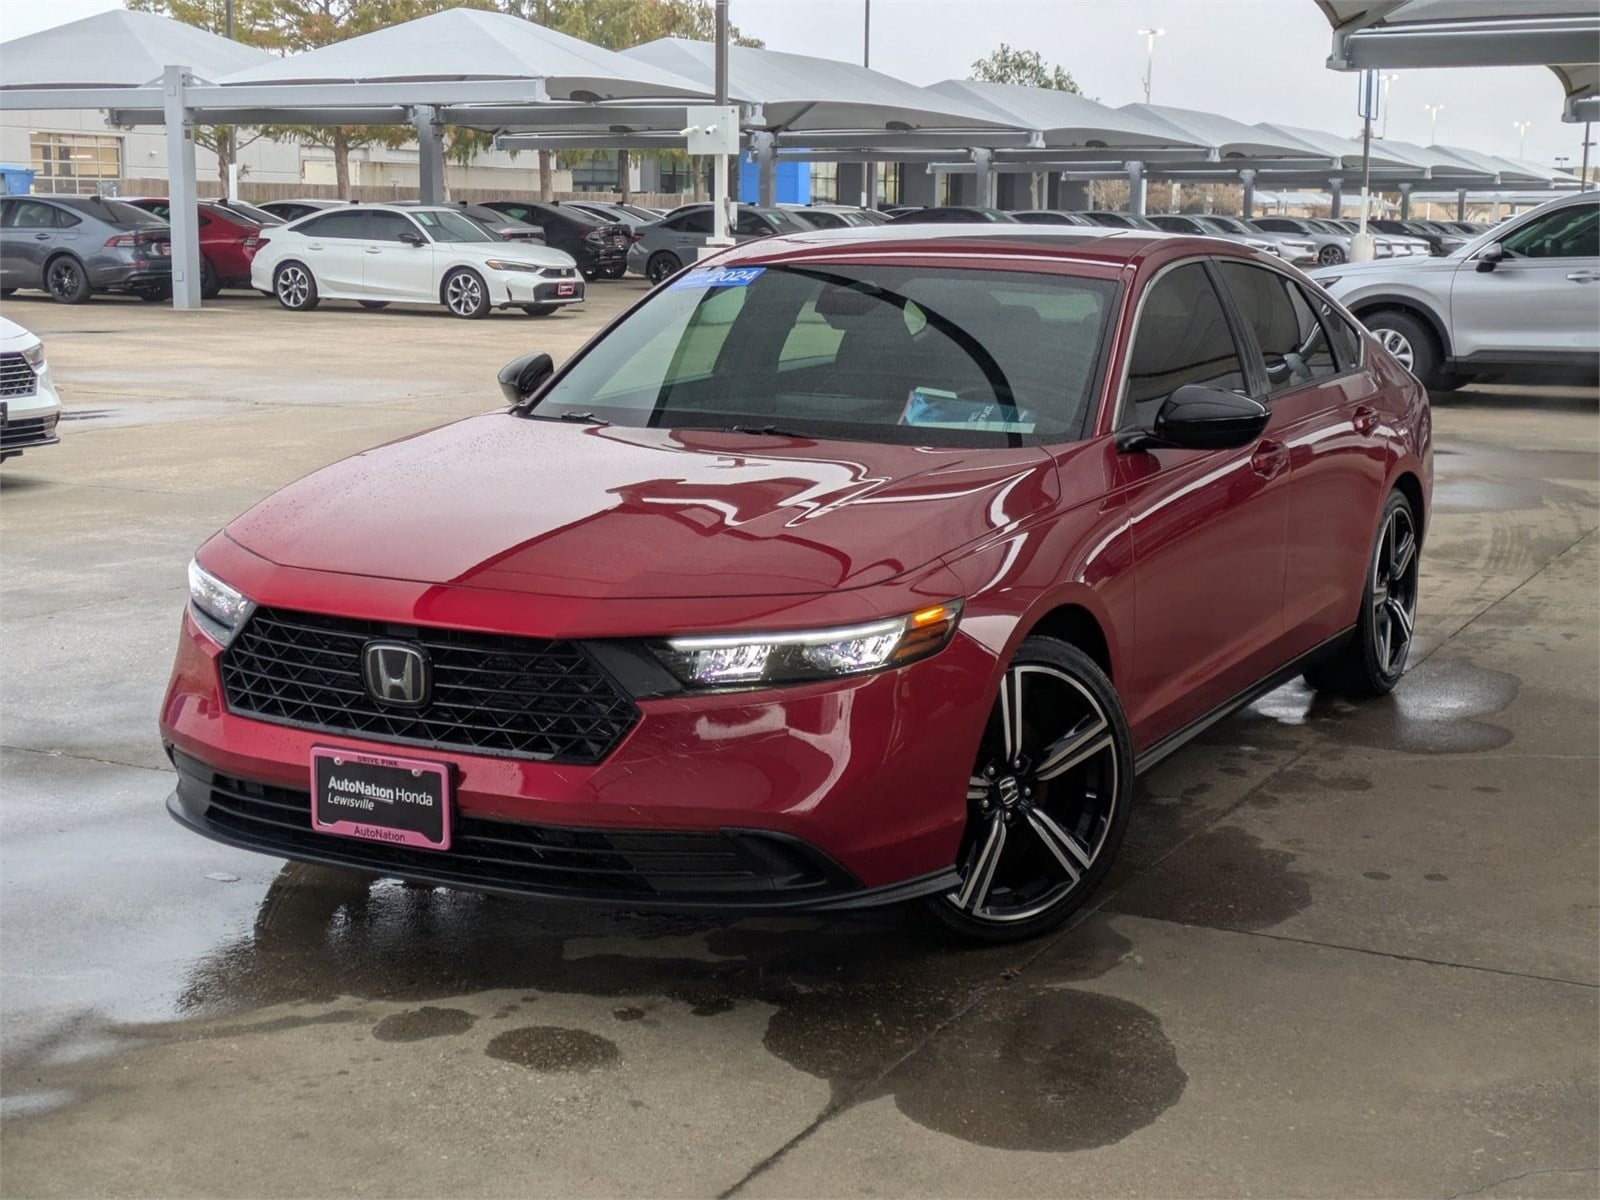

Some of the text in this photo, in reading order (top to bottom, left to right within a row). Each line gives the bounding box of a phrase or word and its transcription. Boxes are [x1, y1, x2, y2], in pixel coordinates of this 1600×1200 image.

[707, 270, 758, 282] 2024
[328, 776, 433, 806] AutoNation Honda
[327, 792, 375, 811] Lewisville
[353, 826, 406, 842] AutoNation
